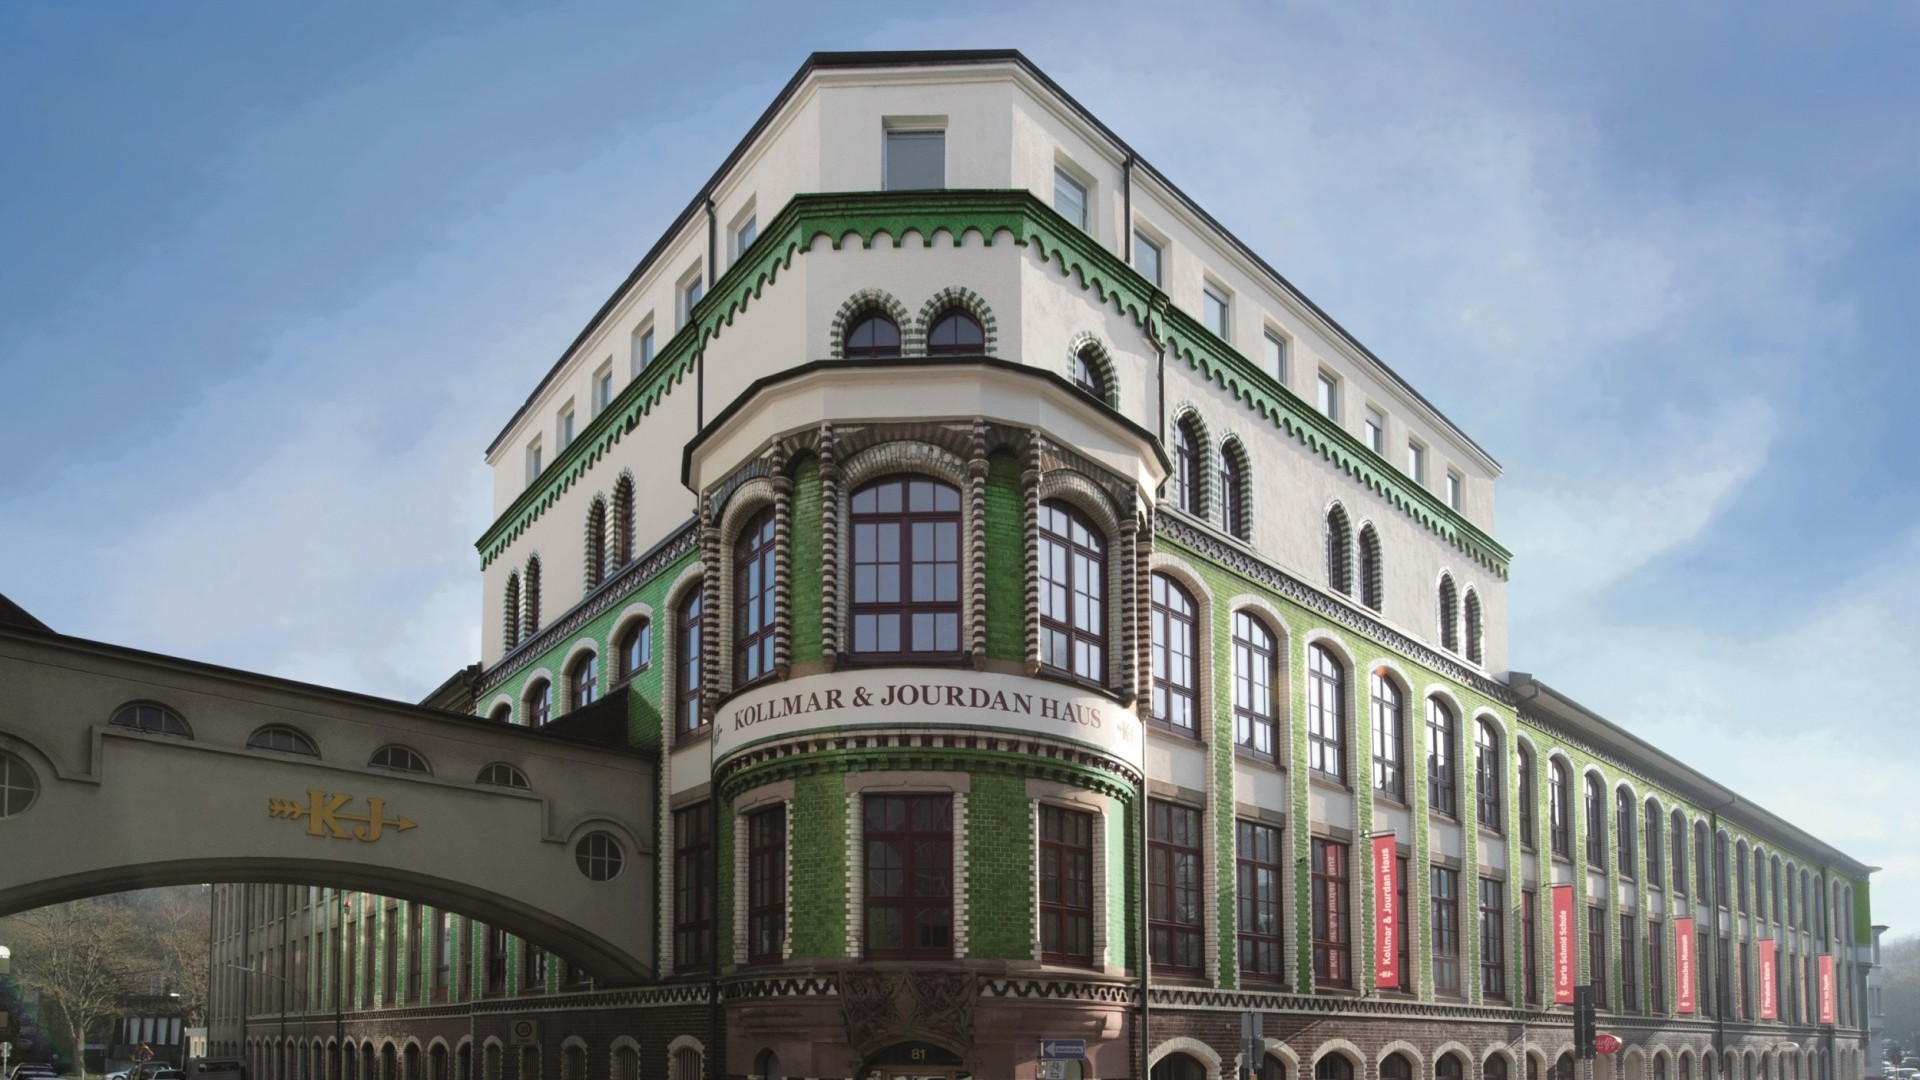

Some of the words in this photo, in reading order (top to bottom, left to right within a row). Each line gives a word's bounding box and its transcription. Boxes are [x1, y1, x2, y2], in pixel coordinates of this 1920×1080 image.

[734, 689, 845, 731] KOLLMAR
[852, 686, 874, 707] &
[881, 684, 1033, 715] JOURDAN
[1040, 697, 1101, 728] HAUS
[306, 788, 386, 843] KJ
[1381, 848, 1390, 872] Haus
[1382, 875, 1391, 914] Jourdan
[1382, 915, 1392, 924] &
[1558, 910, 1567, 935] Schule
[1382, 927, 1392, 965] Kollmar
[1559, 936, 1568, 964] Schmid
[1560, 965, 1568, 986] Carlo
[911, 1048, 926, 1060] 81
